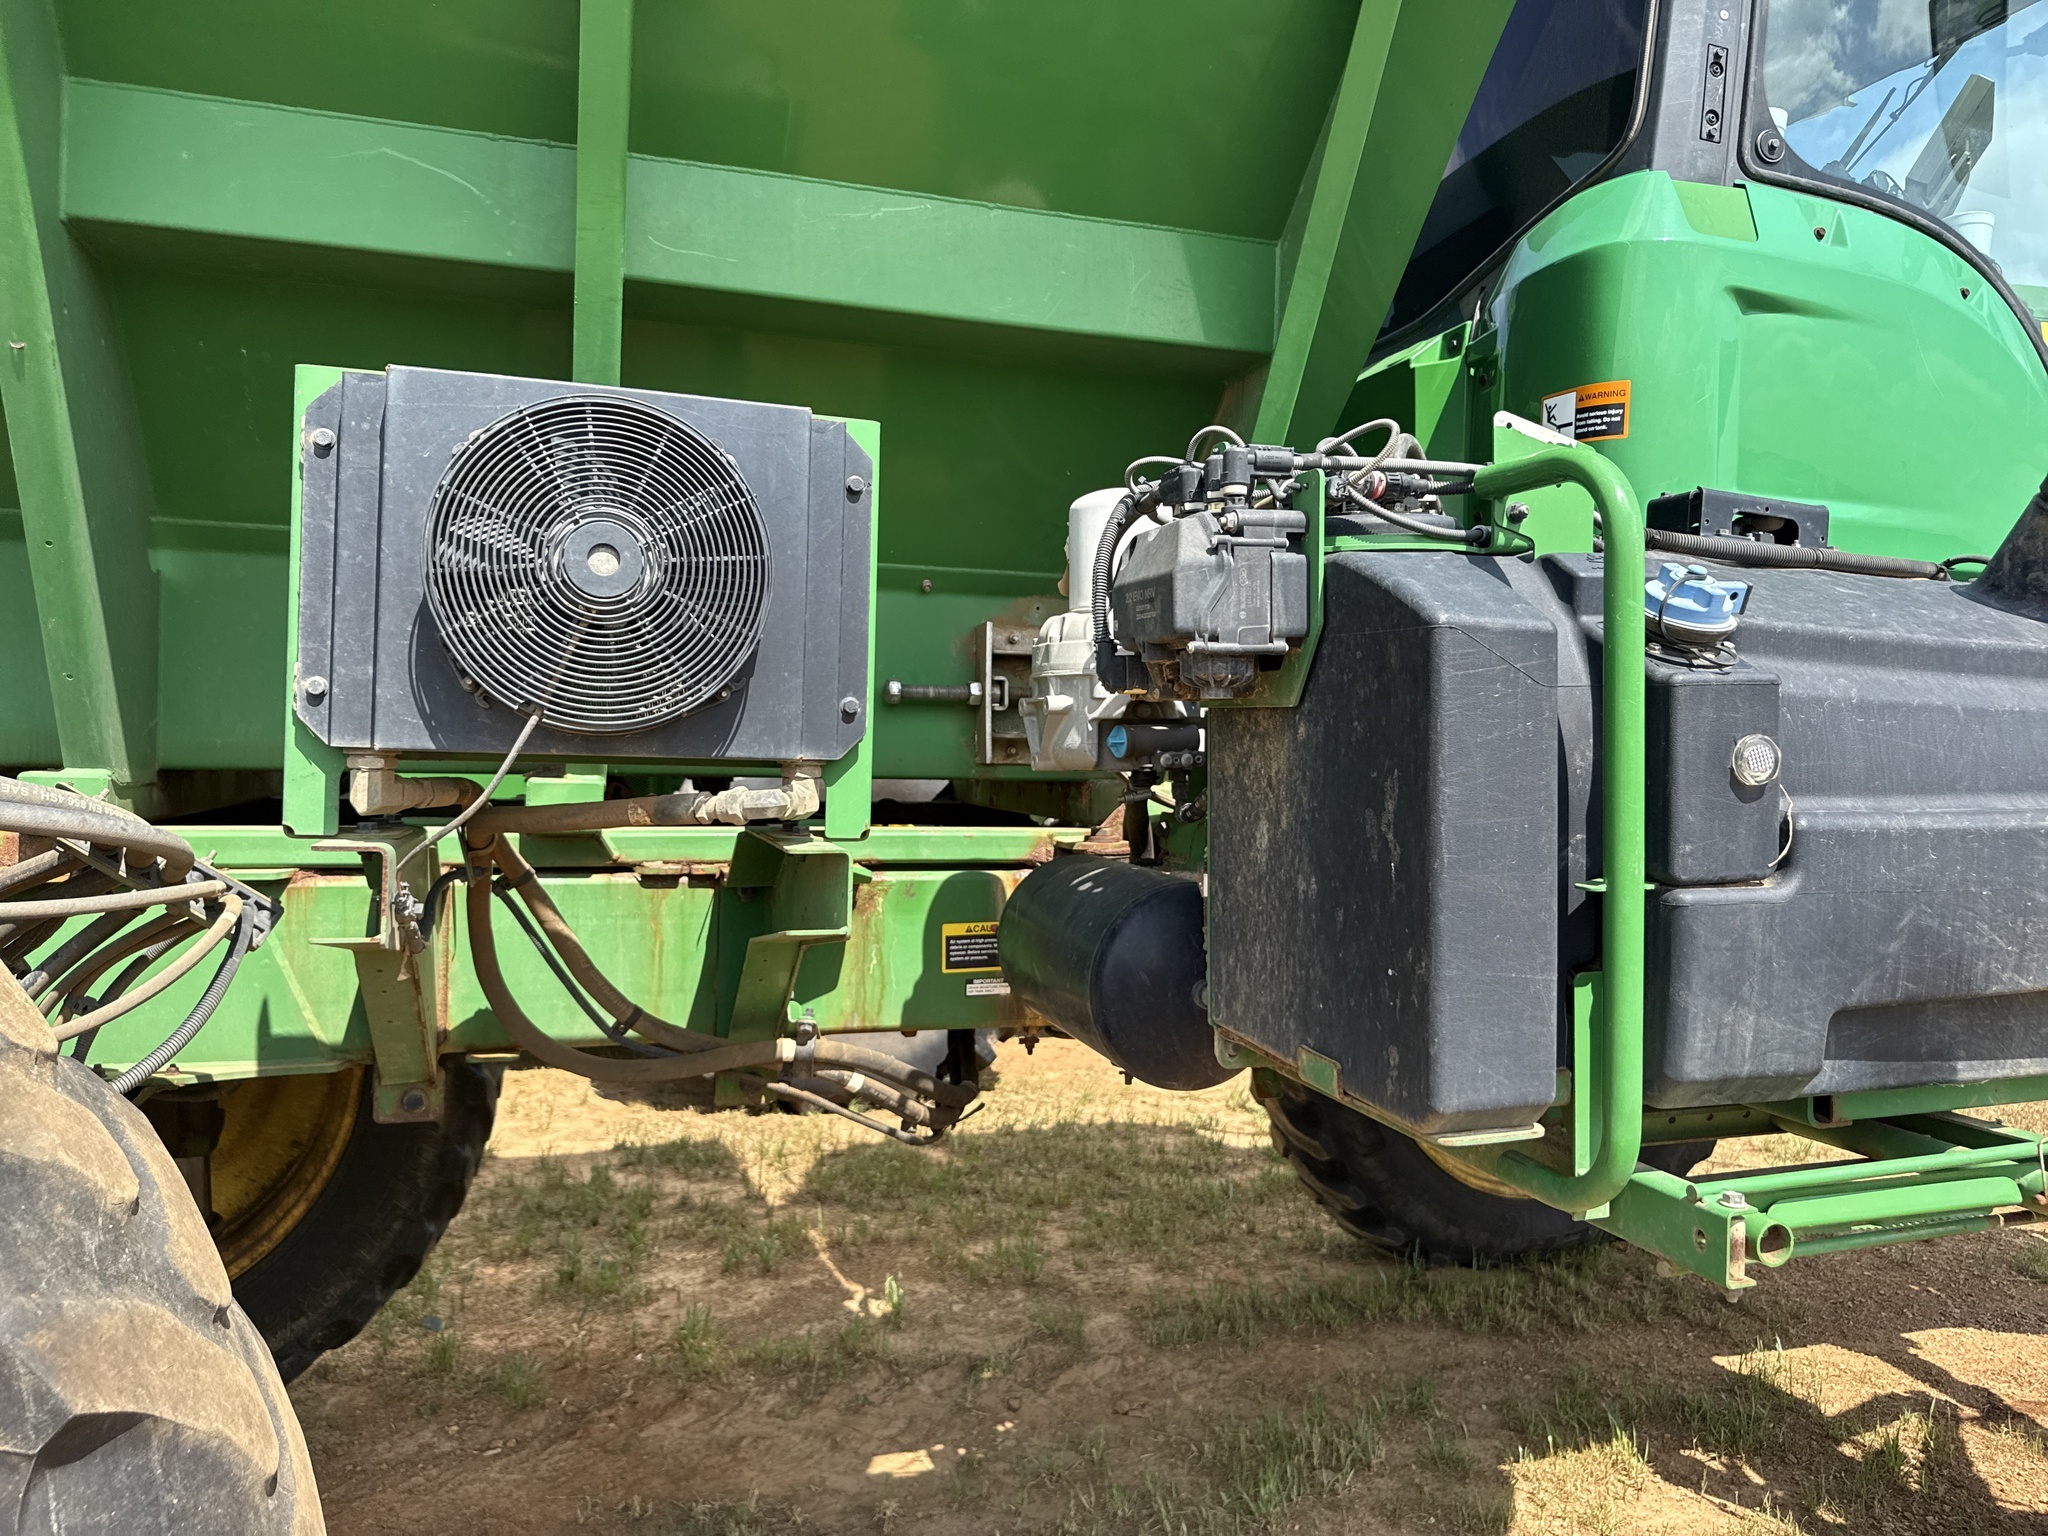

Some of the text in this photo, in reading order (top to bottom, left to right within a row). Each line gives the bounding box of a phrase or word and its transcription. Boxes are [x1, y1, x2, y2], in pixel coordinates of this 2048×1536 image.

[1585, 390, 1626, 400] WARNING
[1133, 590, 1143, 602] EVO
[1, 782, 30, 797] SAE
[40, 790, 65, 803] 4SH
[68, 796, 87, 809] 856
[89, 802, 102, 813] EN
